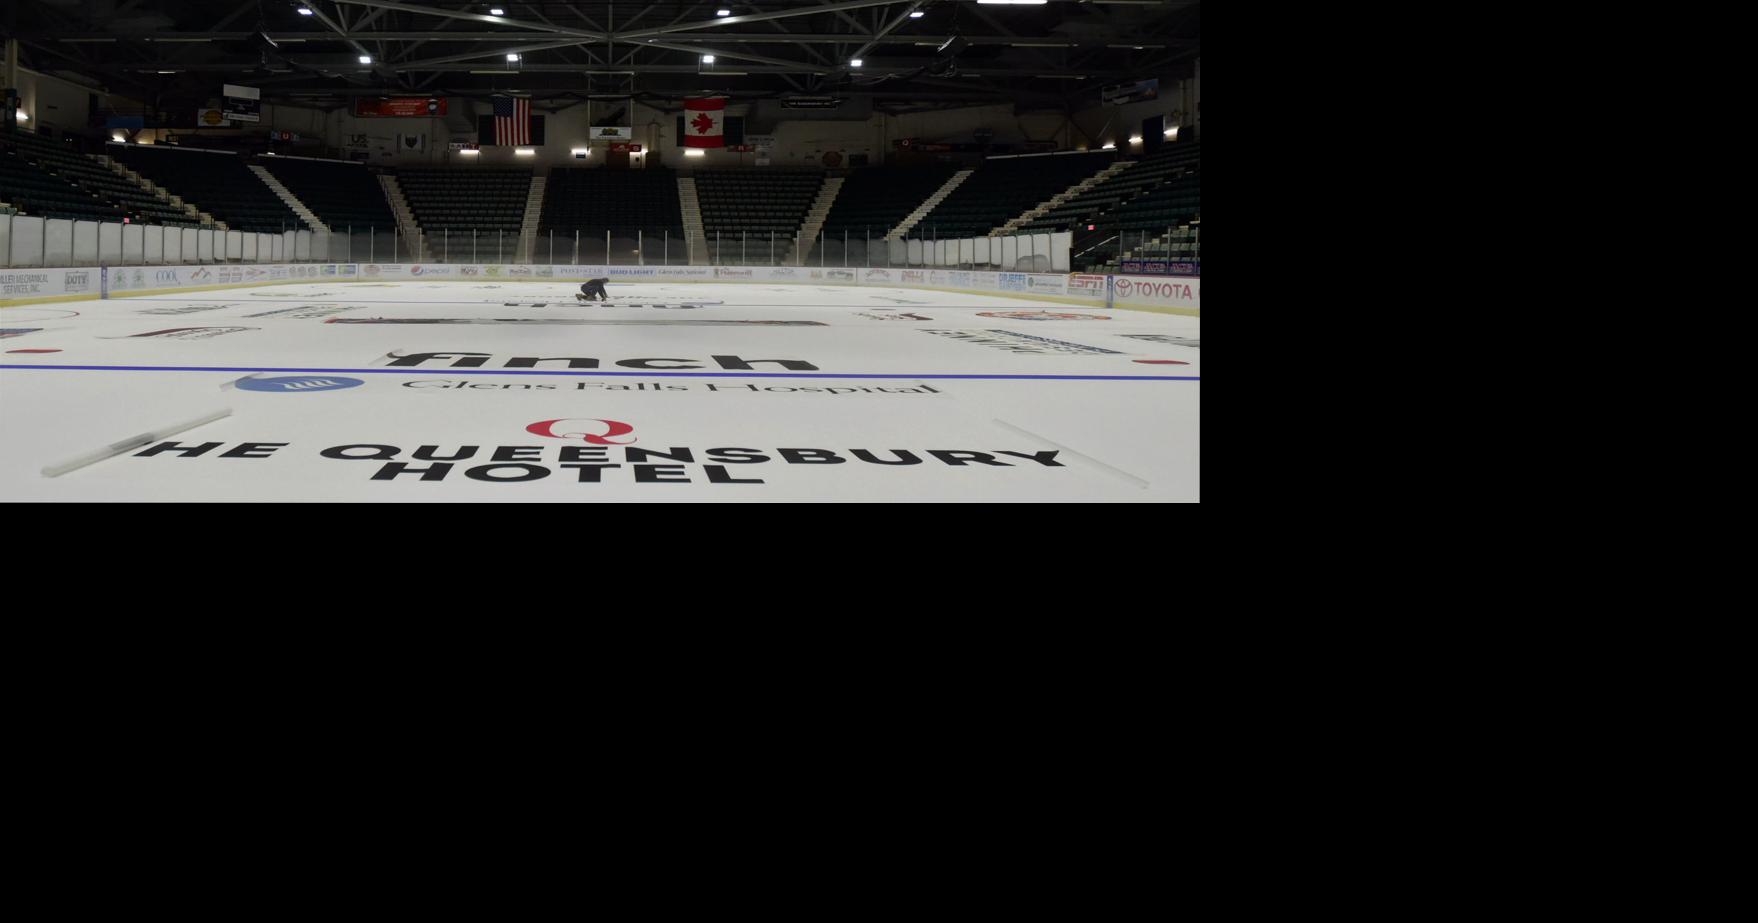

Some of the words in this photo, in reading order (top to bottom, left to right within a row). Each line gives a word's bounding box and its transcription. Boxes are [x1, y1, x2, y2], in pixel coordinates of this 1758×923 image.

[1134, 281, 1193, 300] TOYOTA
[385, 352, 820, 372] finch
[402, 380, 557, 390] Glens
[577, 382, 689, 391] Falls
[706, 383, 941, 395] Hospital
[526, 418, 638, 446] Q
[132, 441, 291, 458] HE
[319, 444, 1067, 467] QUEENSBURY
[369, 462, 767, 485] HOTEL
